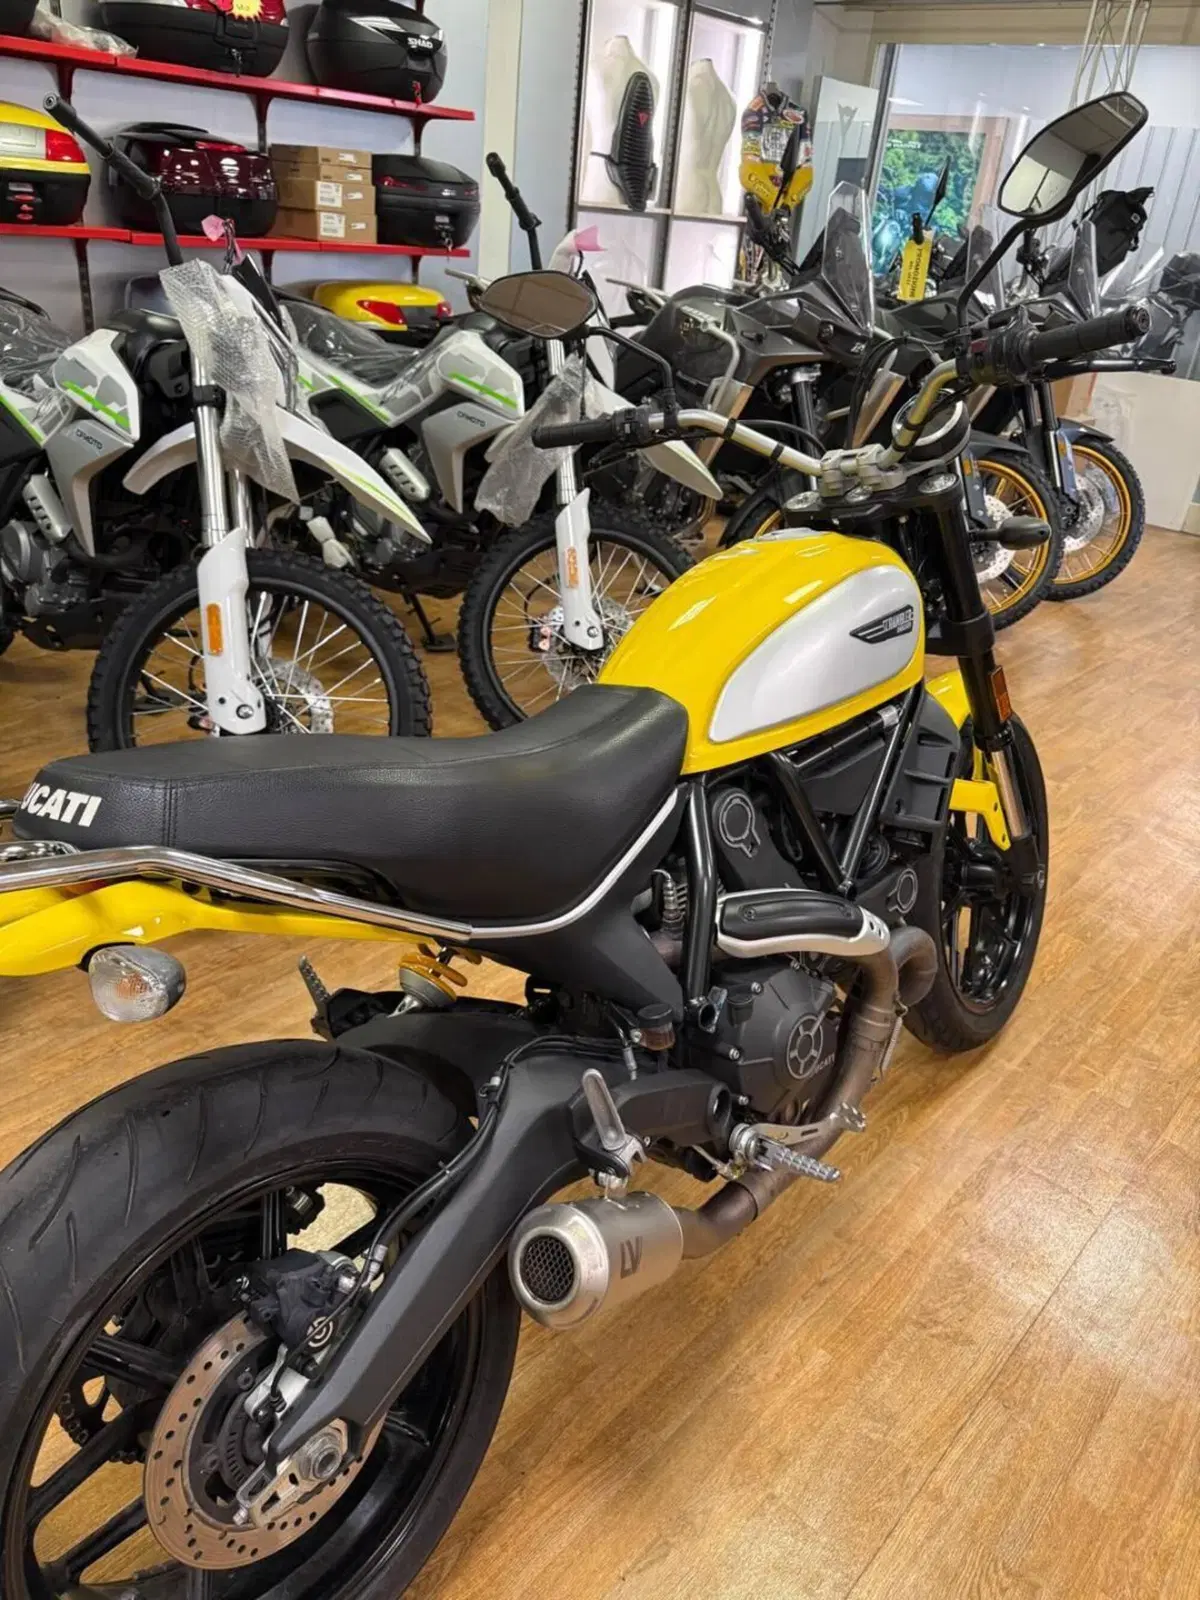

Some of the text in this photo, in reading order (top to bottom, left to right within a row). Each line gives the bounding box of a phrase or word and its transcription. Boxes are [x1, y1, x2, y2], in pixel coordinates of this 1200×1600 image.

[407, 37, 434, 49] SHAD
[20, 781, 103, 828] UCATI
[620, 1236, 643, 1279] LV
